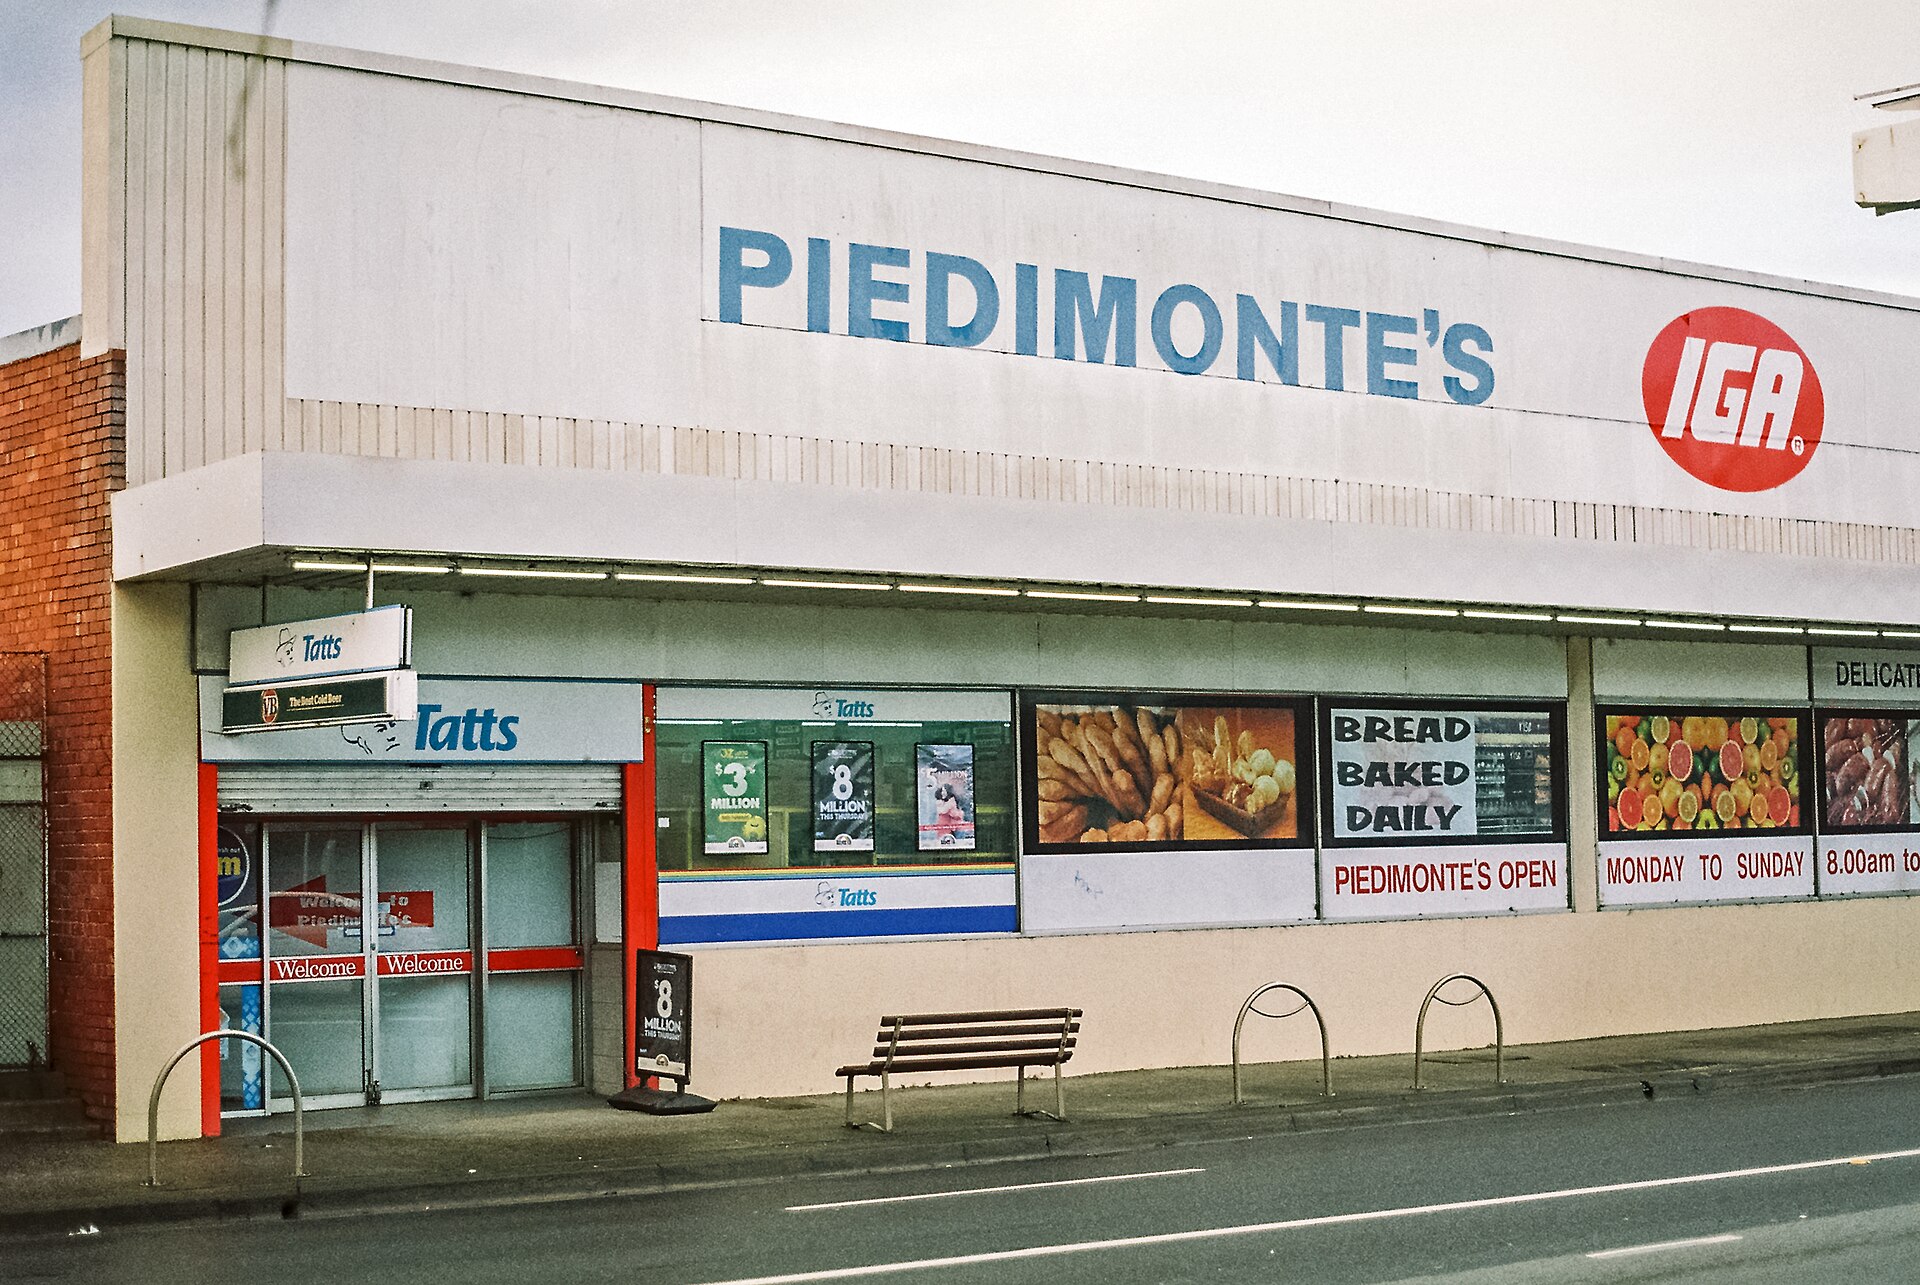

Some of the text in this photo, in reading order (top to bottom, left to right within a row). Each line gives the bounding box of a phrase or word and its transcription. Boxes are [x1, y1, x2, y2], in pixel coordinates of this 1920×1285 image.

[718, 226, 1496, 405] PIEDIMONTE'S
[1661, 336, 1804, 451] IGA
[303, 634, 342, 662] Tatts
[836, 699, 874, 719] Tatts
[414, 703, 519, 752] Tatts
[1334, 716, 1472, 743] BREAD
[1336, 761, 1470, 788] BAKED
[711, 798, 760, 809] MILLION
[820, 801, 866, 813] MILLION
[1346, 804, 1463, 833] DAILY
[1606, 851, 1804, 884] MONDAY TO SUNDAY
[1827, 848, 1920, 875] 8.00am to
[1335, 858, 1557, 895] PIEDIMONTE'S OPEN
[389, 895, 409, 906] to
[838, 888, 877, 906] Tatts
[274, 955, 463, 979] Welcome Welcome
[644, 1016, 681, 1033] MILLION
